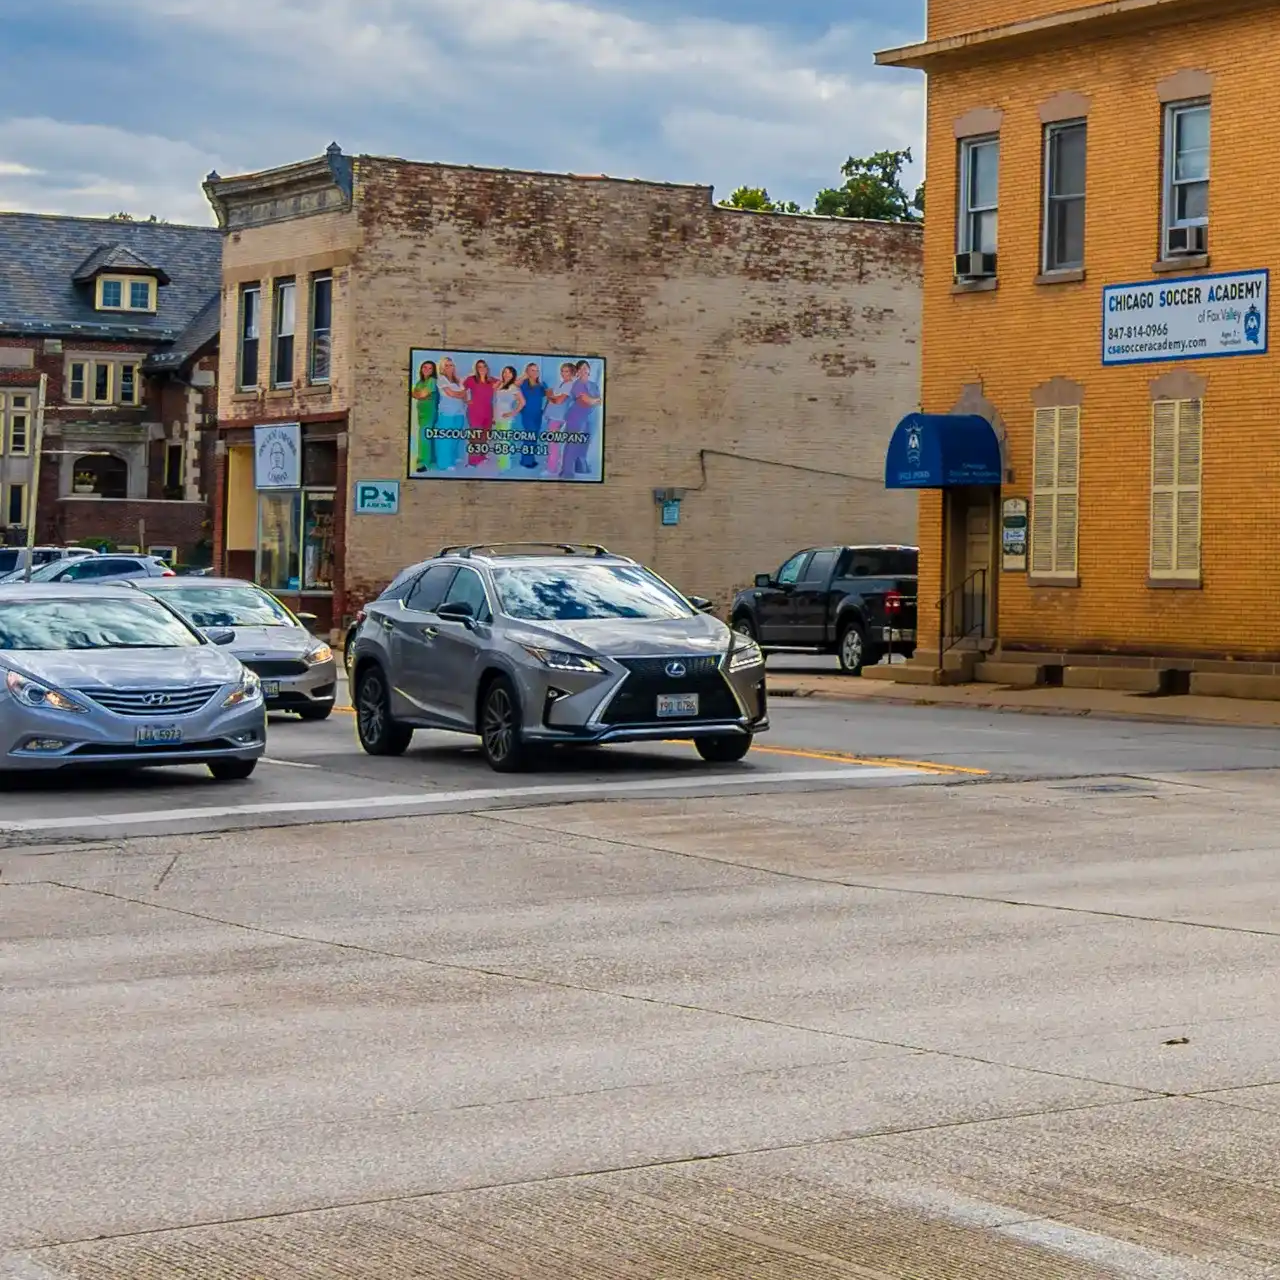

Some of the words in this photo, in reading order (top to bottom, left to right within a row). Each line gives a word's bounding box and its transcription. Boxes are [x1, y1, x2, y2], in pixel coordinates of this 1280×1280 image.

[1109, 292, 1154, 312] CHICAGO
[1159, 287, 1201, 307] SOCCER
[1207, 281, 1262, 303] ACADEMY
[1197, 311, 1205, 323] of
[1206, 310, 1220, 321] Fox
[1220, 307, 1242, 324] Valley
[1108, 323, 1169, 340] 847-814-0966
[1108, 337, 1207, 355] csasocceracademy.com
[425, 428, 483, 440] DISCOUNT
[486, 430, 537, 442] UNIFORM
[539, 431, 591, 444] COMPANY
